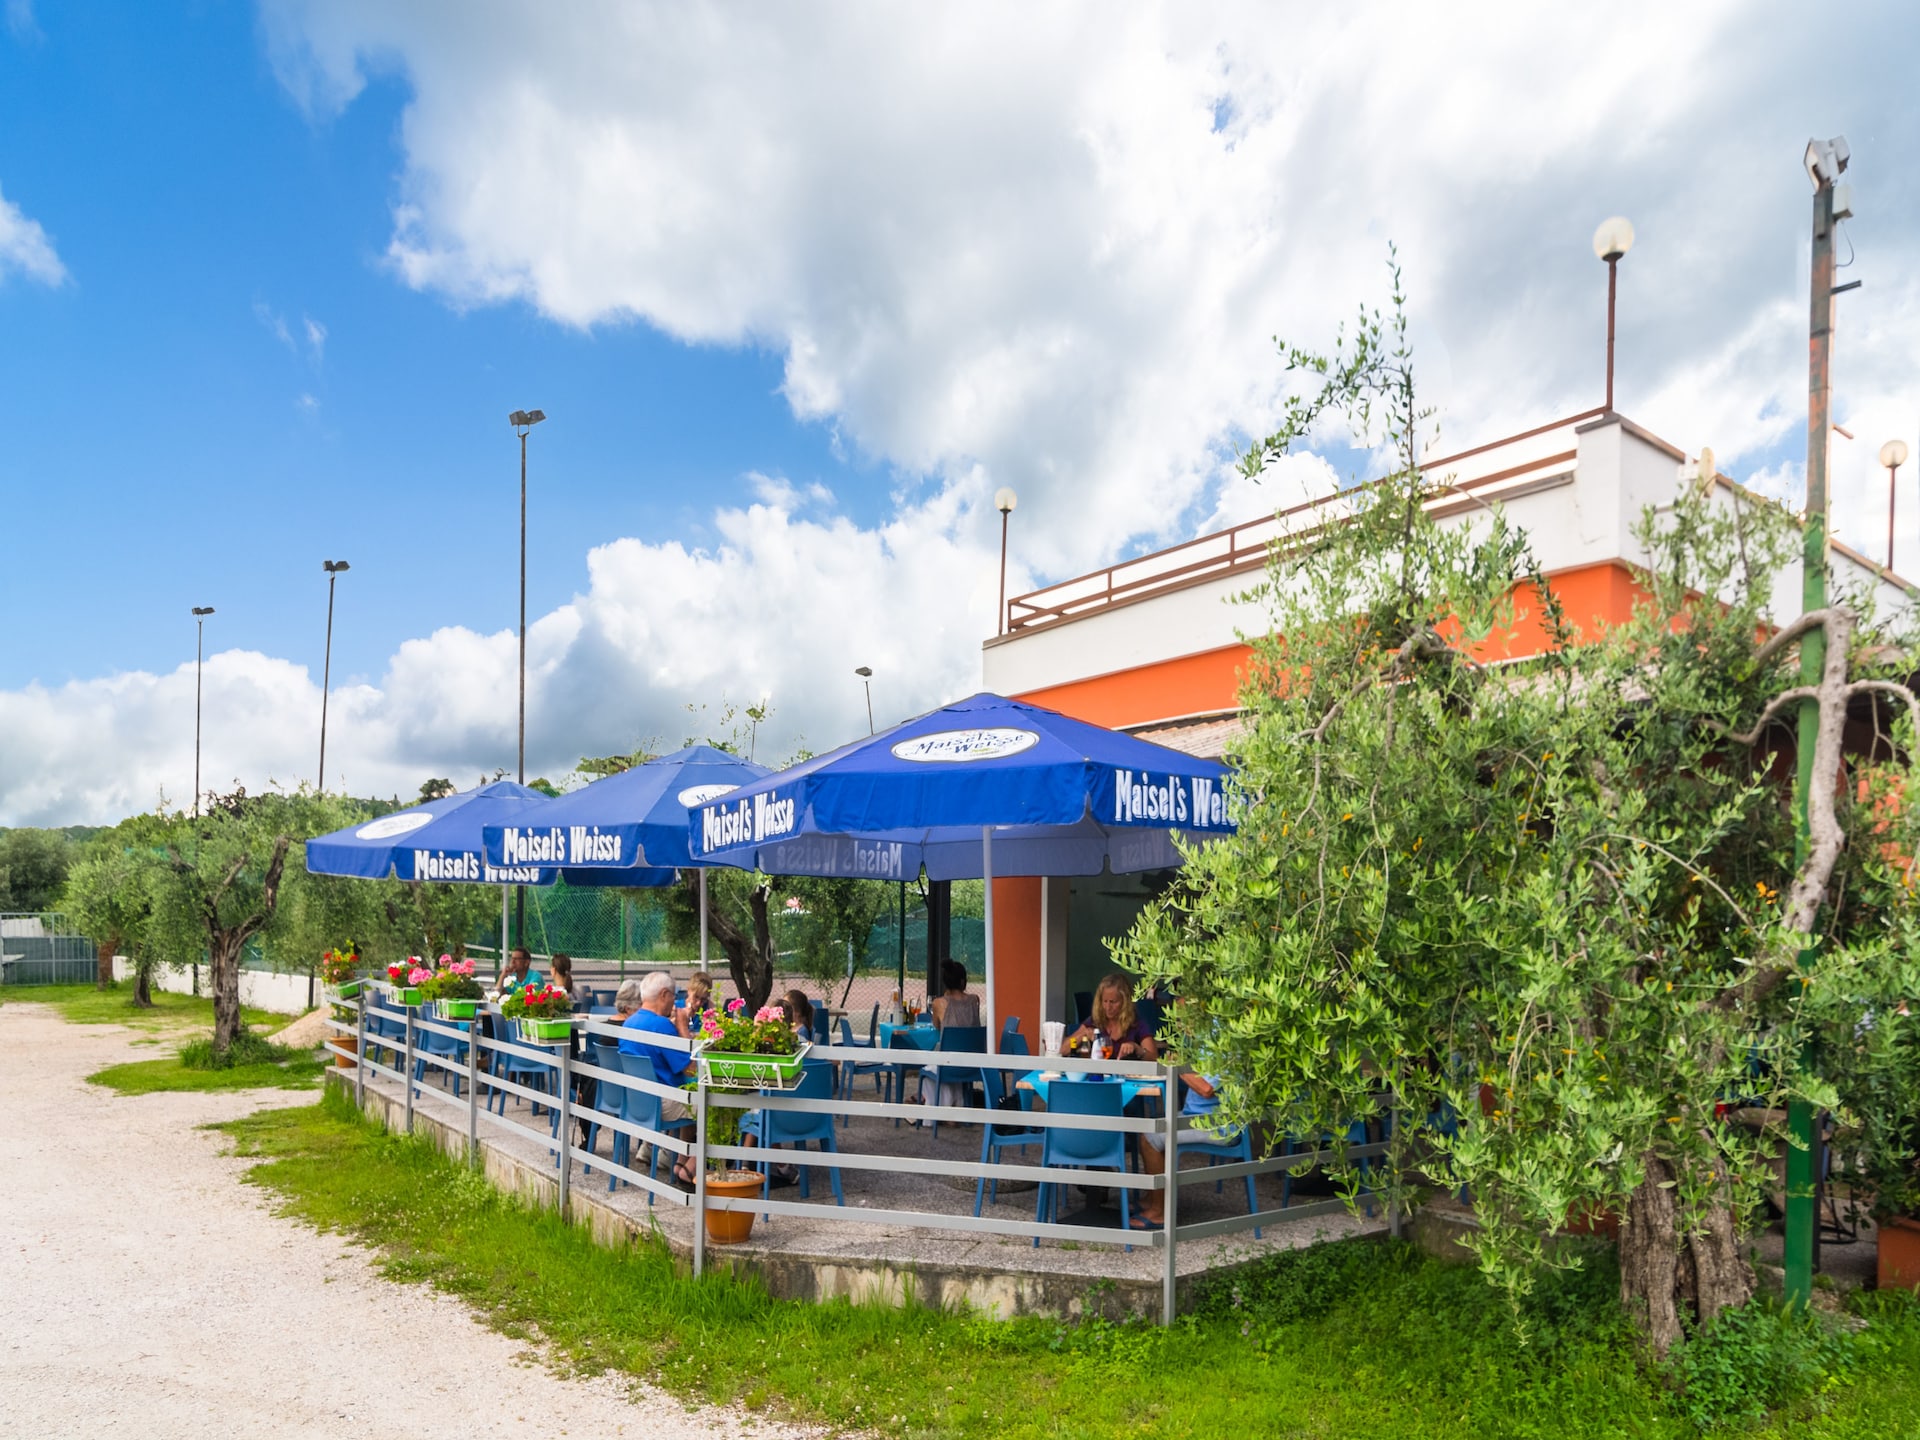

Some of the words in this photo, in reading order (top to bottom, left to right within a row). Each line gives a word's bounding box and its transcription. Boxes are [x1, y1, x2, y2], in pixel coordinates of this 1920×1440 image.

[702, 798, 753, 854] Maisel's
[754, 790, 795, 842] Weisse
[1114, 769, 1188, 822] Maisel's
[1191, 777, 1247, 828] Wei
[414, 849, 480, 881] Maisel's
[503, 826, 566, 865] Maisel's
[569, 825, 622, 864] Weisse
